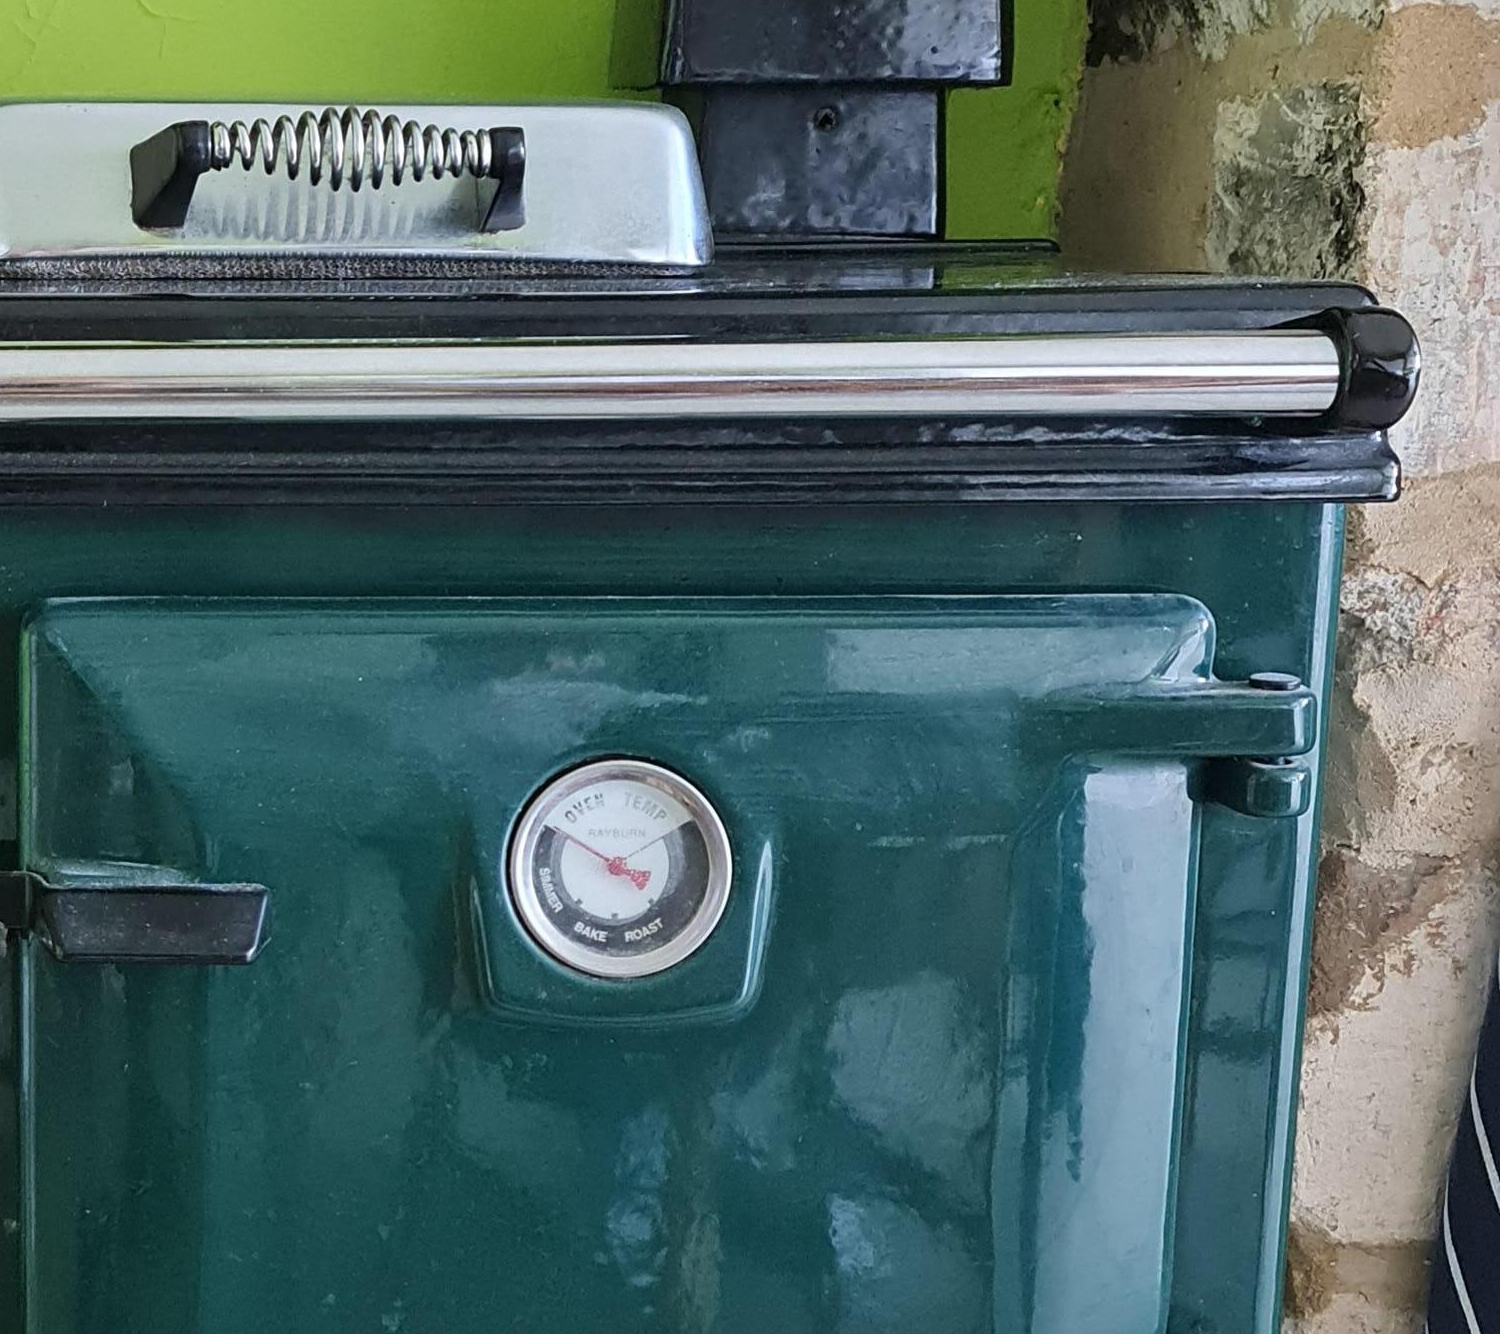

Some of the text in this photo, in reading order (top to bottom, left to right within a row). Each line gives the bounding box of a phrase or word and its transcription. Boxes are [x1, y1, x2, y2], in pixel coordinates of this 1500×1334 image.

[565, 792, 667, 824] OVEN TEMP
[588, 828, 647, 839] RAYBURN
[539, 867, 564, 914] SIMMER
[573, 917, 664, 943] BAKE ROAST
